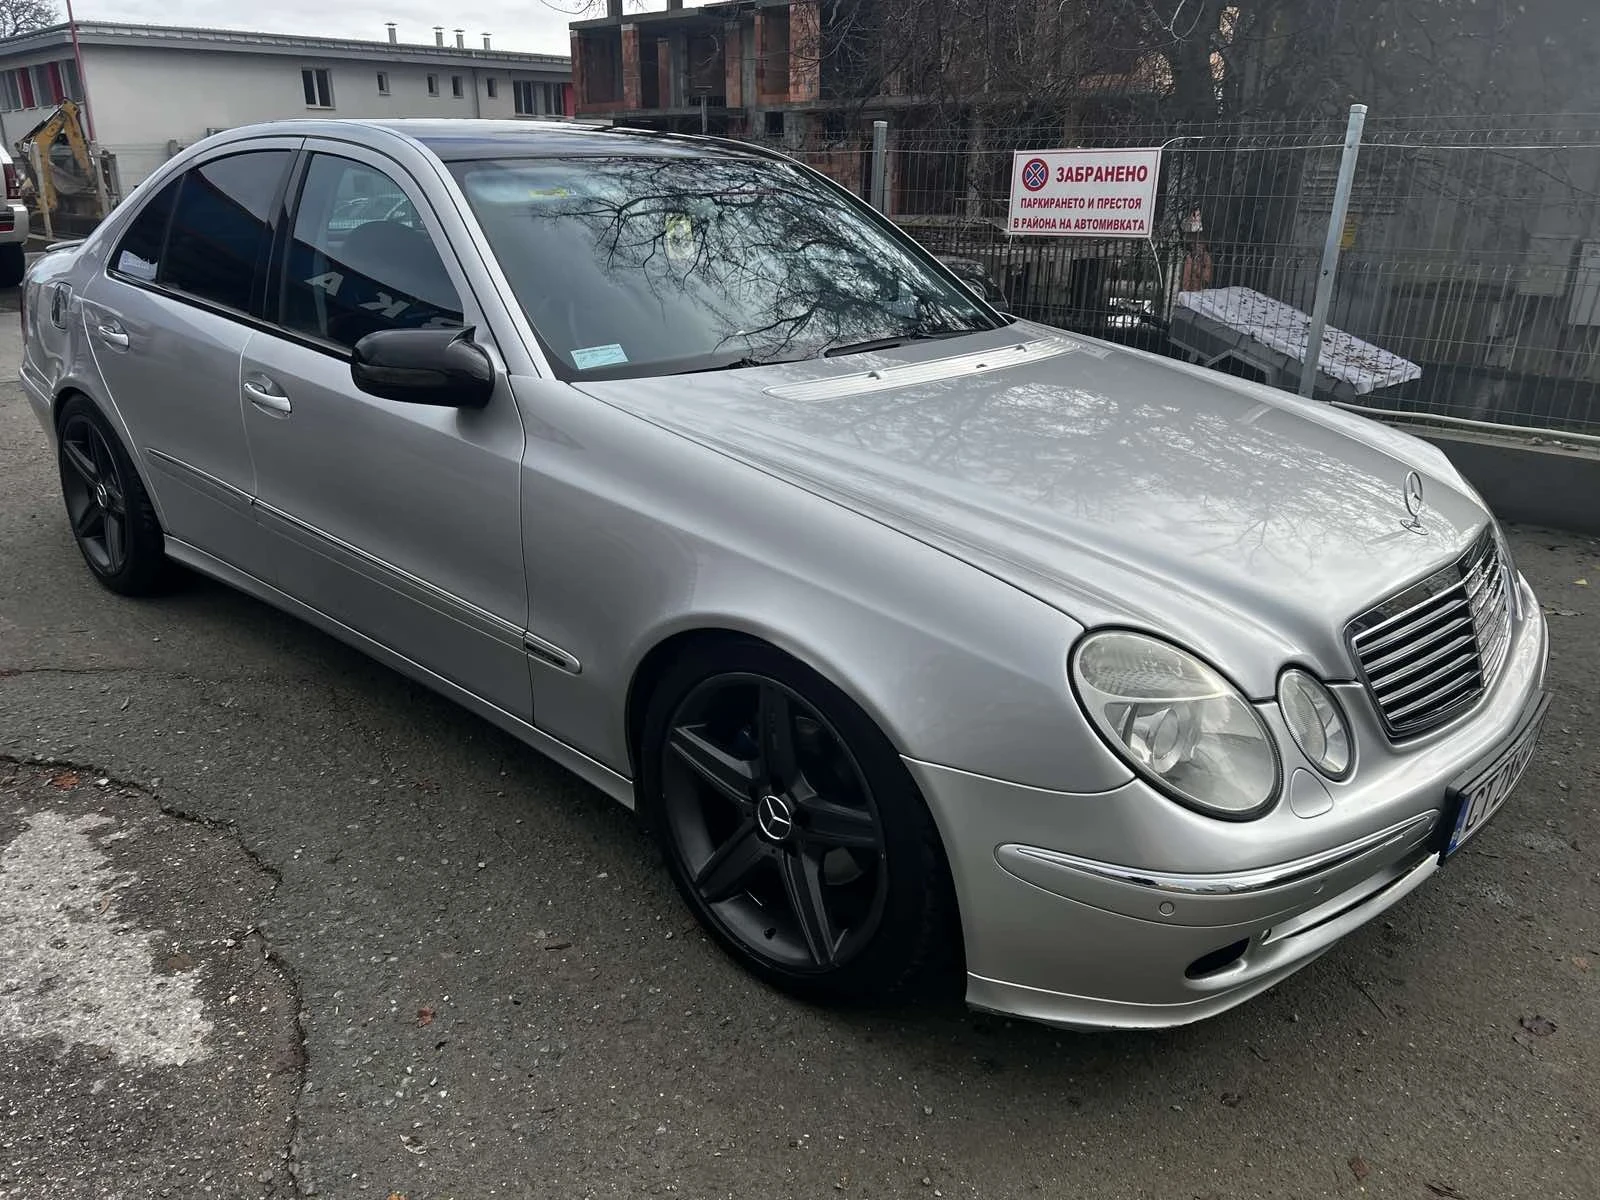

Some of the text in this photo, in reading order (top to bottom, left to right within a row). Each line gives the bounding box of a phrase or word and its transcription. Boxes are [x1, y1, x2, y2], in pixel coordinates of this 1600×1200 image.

[1056, 165, 1148, 183] ЗАБРАНЕНО
[1020, 197, 1142, 209] ПАРКИРАНЕТО И ПРЕСТОЯ
[1013, 216, 1145, 231] В РАЙОНА НА АВТОМИВКАТА
